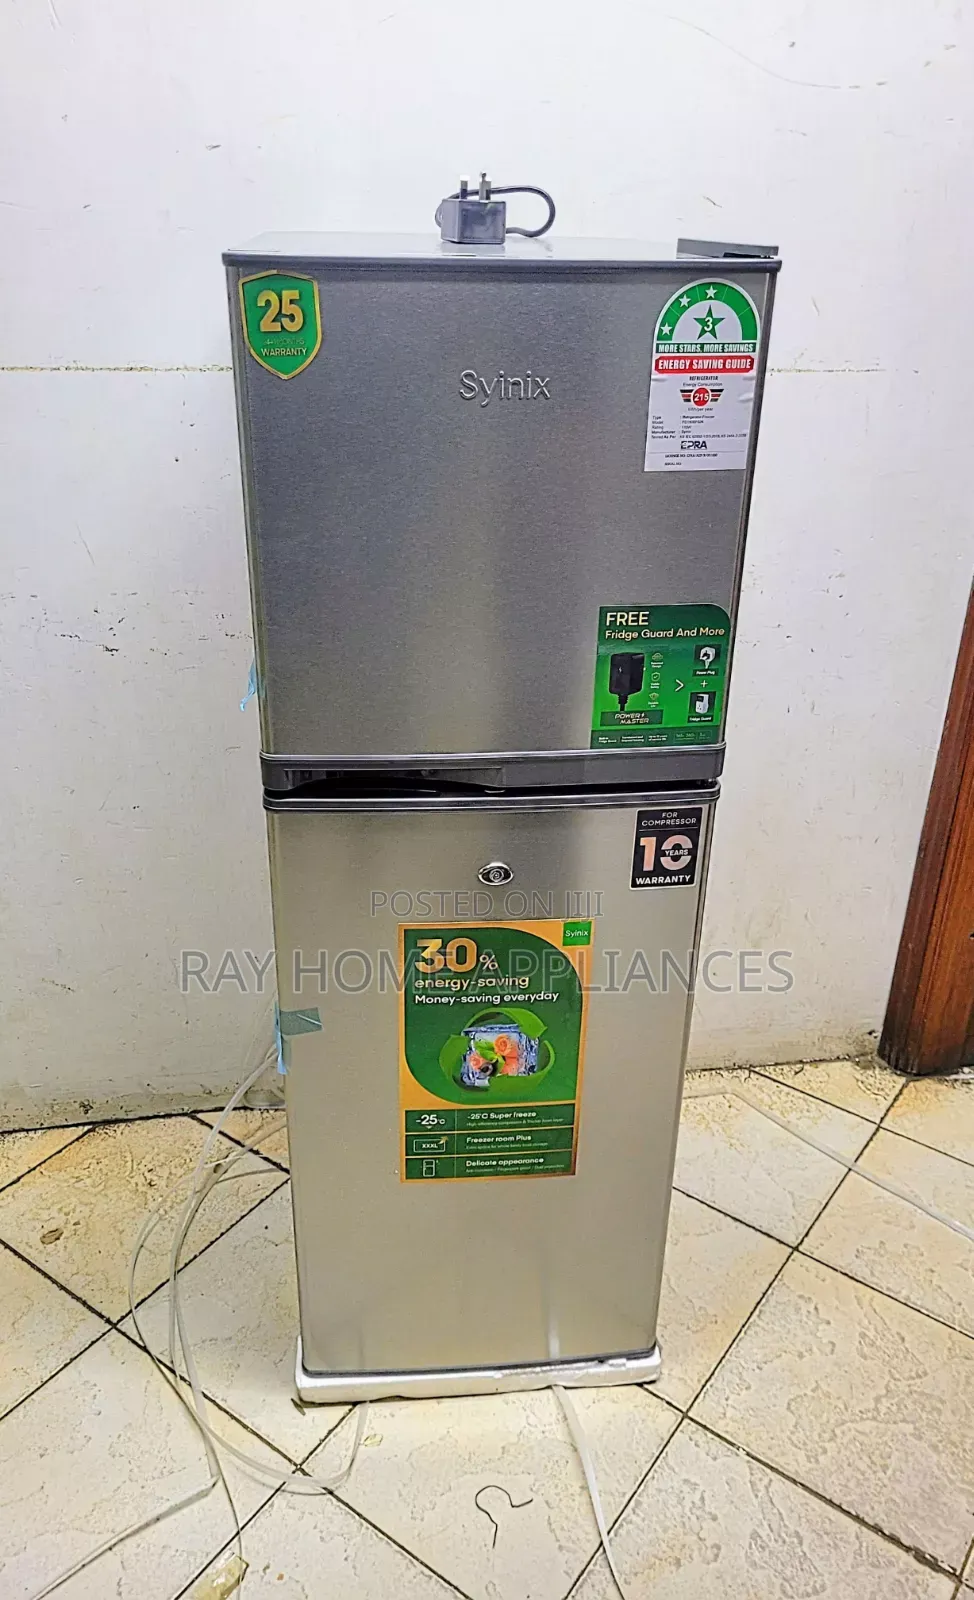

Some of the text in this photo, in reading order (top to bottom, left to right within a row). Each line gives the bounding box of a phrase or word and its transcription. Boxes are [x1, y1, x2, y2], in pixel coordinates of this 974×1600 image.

[257, 290, 304, 332] 25
[704, 317, 713, 331] 3
[261, 347, 307, 357] WARRANTY
[658, 344, 678, 353] MORE
[704, 344, 722, 352] MORE
[724, 343, 754, 352] SAVINGS
[658, 359, 751, 370] ENERGY SAVING GUIDE
[460, 369, 551, 408] Syinix
[694, 393, 709, 401] 215
[680, 440, 707, 449] EPRA
[605, 611, 650, 626] FREE
[605, 627, 725, 641] Fridge Guard And More
[641, 818, 697, 826] COMPRESSOR
[640, 834, 693, 871] 10
[635, 875, 691, 885] WARRANTY
[565, 929, 589, 939] Syinix
[414, 974, 530, 991] energy-saving
[414, 991, 559, 1006] Money-saving everyday
[489, 1112, 512, 1120] Super
[498, 1157, 544, 1166] appearance
